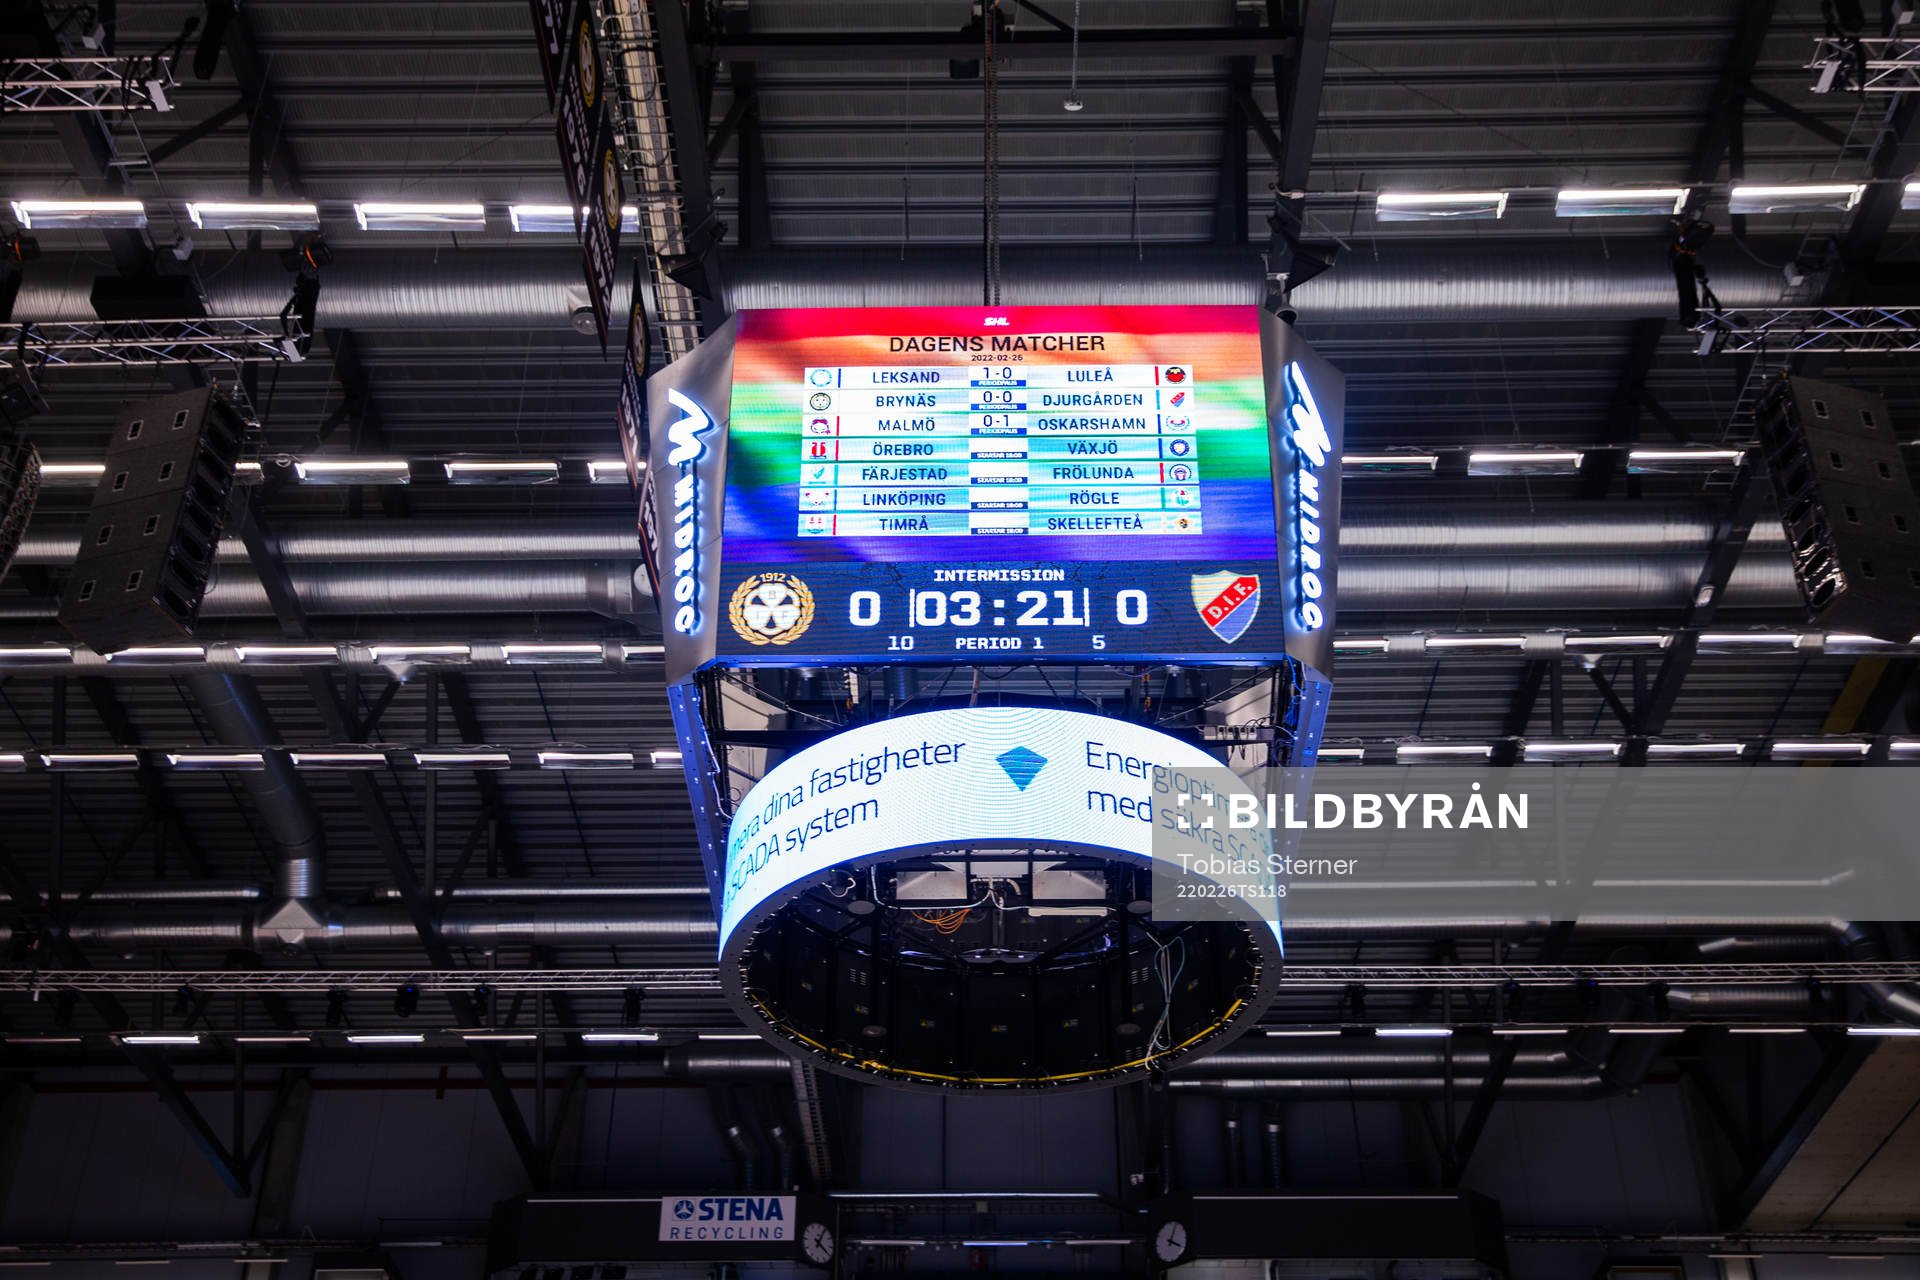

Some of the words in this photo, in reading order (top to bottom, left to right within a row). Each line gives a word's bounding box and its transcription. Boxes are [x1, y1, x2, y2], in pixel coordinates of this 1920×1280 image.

[890, 336, 984, 352] DAGENS
[992, 335, 1105, 352] MATCHER
[873, 371, 940, 384] LEKSAND
[1068, 367, 1113, 382] LULEÅ
[876, 393, 936, 407] BRYNÄS
[1043, 390, 1143, 407] DJURGÅRDEN
[878, 416, 935, 431] MALMÖ
[1038, 418, 1145, 431] OSKARSHAMN
[873, 441, 934, 456] ÖREBRO
[1068, 440, 1118, 455] VÄXJÖ
[862, 466, 947, 481] FÄRJESTAD
[1053, 467, 1134, 480] FRÖLUNDA
[863, 491, 946, 506] LINKÖPING
[1070, 490, 1120, 505] RÖGLE
[880, 515, 928, 531] TIMRÅ
[1047, 514, 1143, 531] SKELLEFTEÅ
[760, 572, 787, 583] 1912
[933, 569, 1065, 582] INTERMISSION
[849, 590, 881, 627] 0
[1116, 589, 1148, 626] 0
[1207, 583, 1253, 619] D.I.F.
[888, 635, 914, 651] 10
[956, 637, 1022, 649] PERIOD
[1033, 637, 1044, 649] 1
[1092, 634, 1106, 650] 5
[764, 785, 803, 825] dina
[810, 741, 966, 797] fastigheter
[1088, 790, 1152, 823] med
[731, 834, 780, 900] SCADA
[786, 799, 879, 852] system
[698, 1198, 784, 1221] STENA
[670, 1226, 783, 1239] RECYCLING
